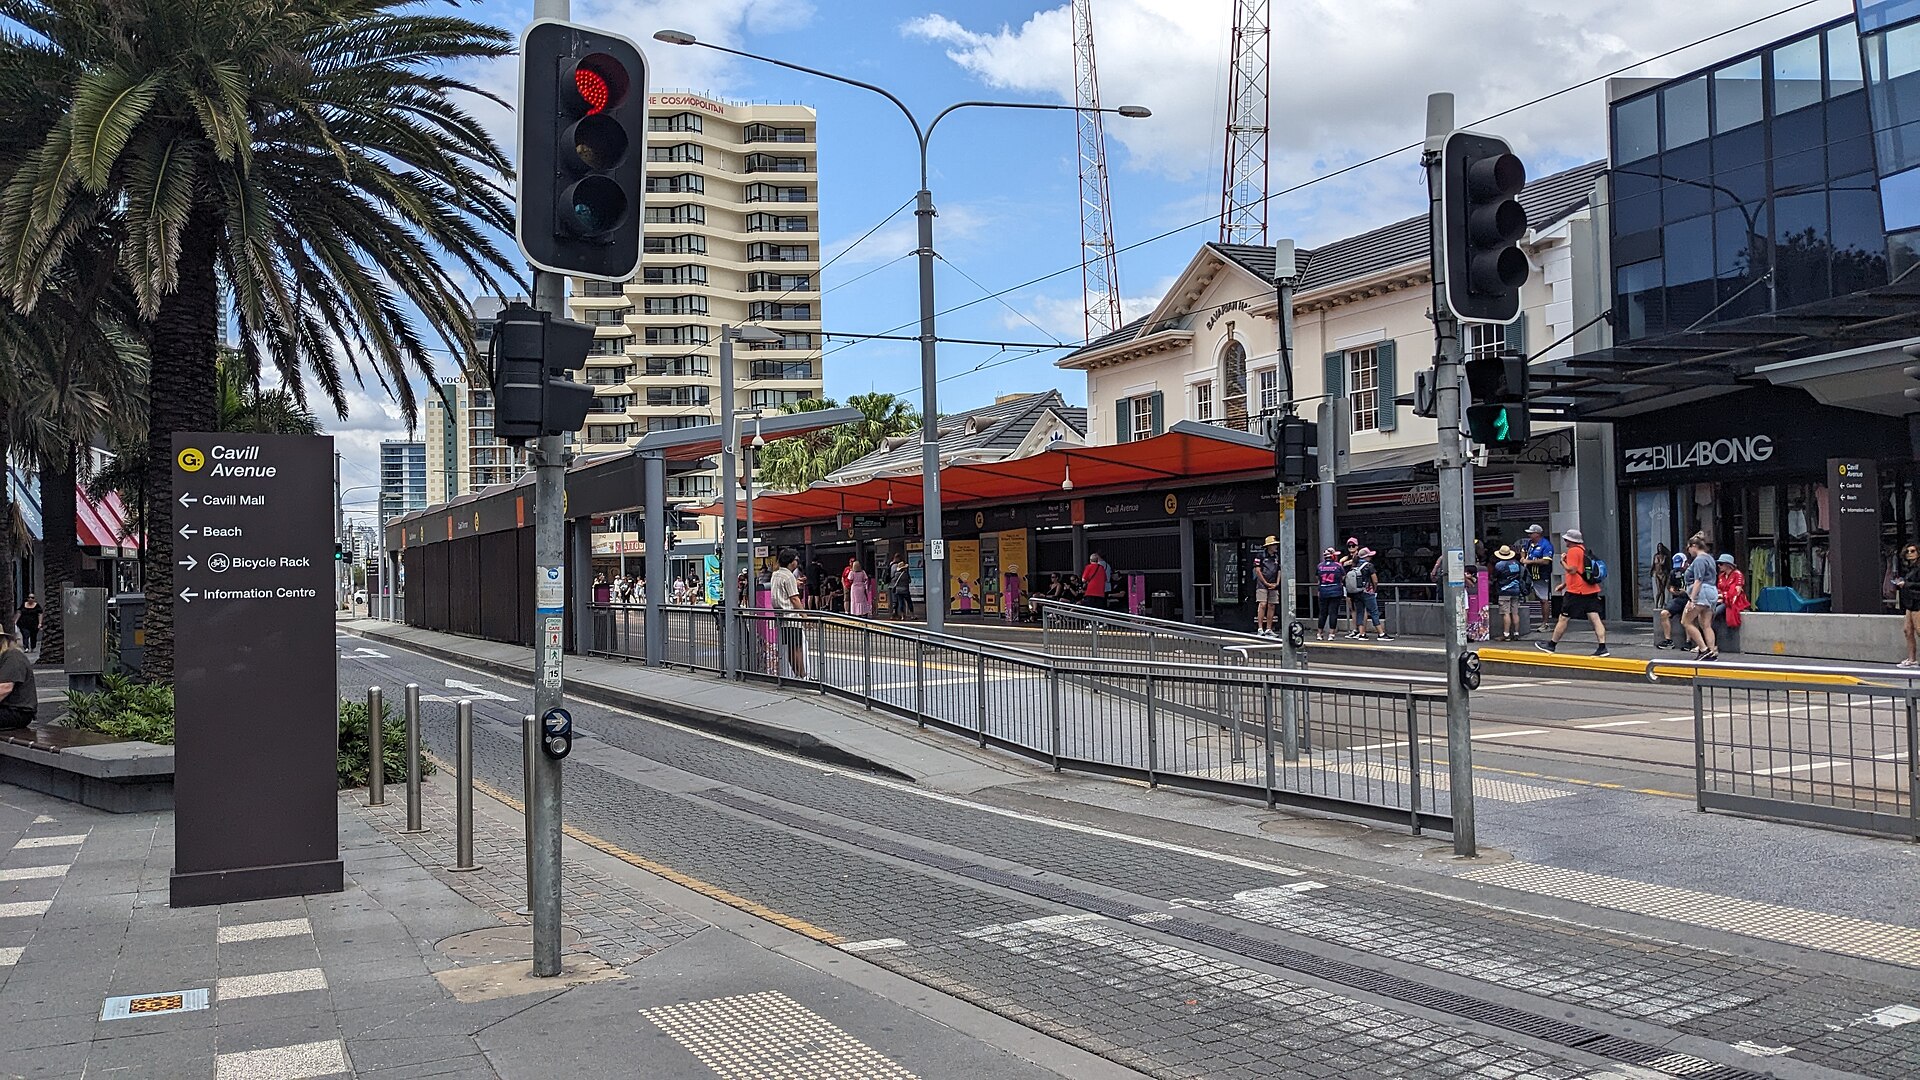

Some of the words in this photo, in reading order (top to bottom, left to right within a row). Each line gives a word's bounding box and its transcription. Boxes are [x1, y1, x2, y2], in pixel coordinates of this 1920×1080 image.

[648, 96, 657, 105] HE
[661, 96, 724, 115] COSMOPOLITAN
[211, 445, 260, 460] Cavill
[1652, 434, 1774, 471] BILLABONG
[210, 463, 277, 478] Avenue
[202, 494, 236, 506] Cavill
[240, 495, 265, 506] Mall
[1402, 491, 1440, 505] CONVENIEN
[1105, 504, 1120, 514] Cavill
[1120, 504, 1139, 512] Avenue
[203, 526, 242, 537] Beach
[232, 557, 277, 570] Bicycle
[279, 556, 310, 567] Rack
[204, 588, 273, 600] Information
[276, 587, 316, 598] Centre
